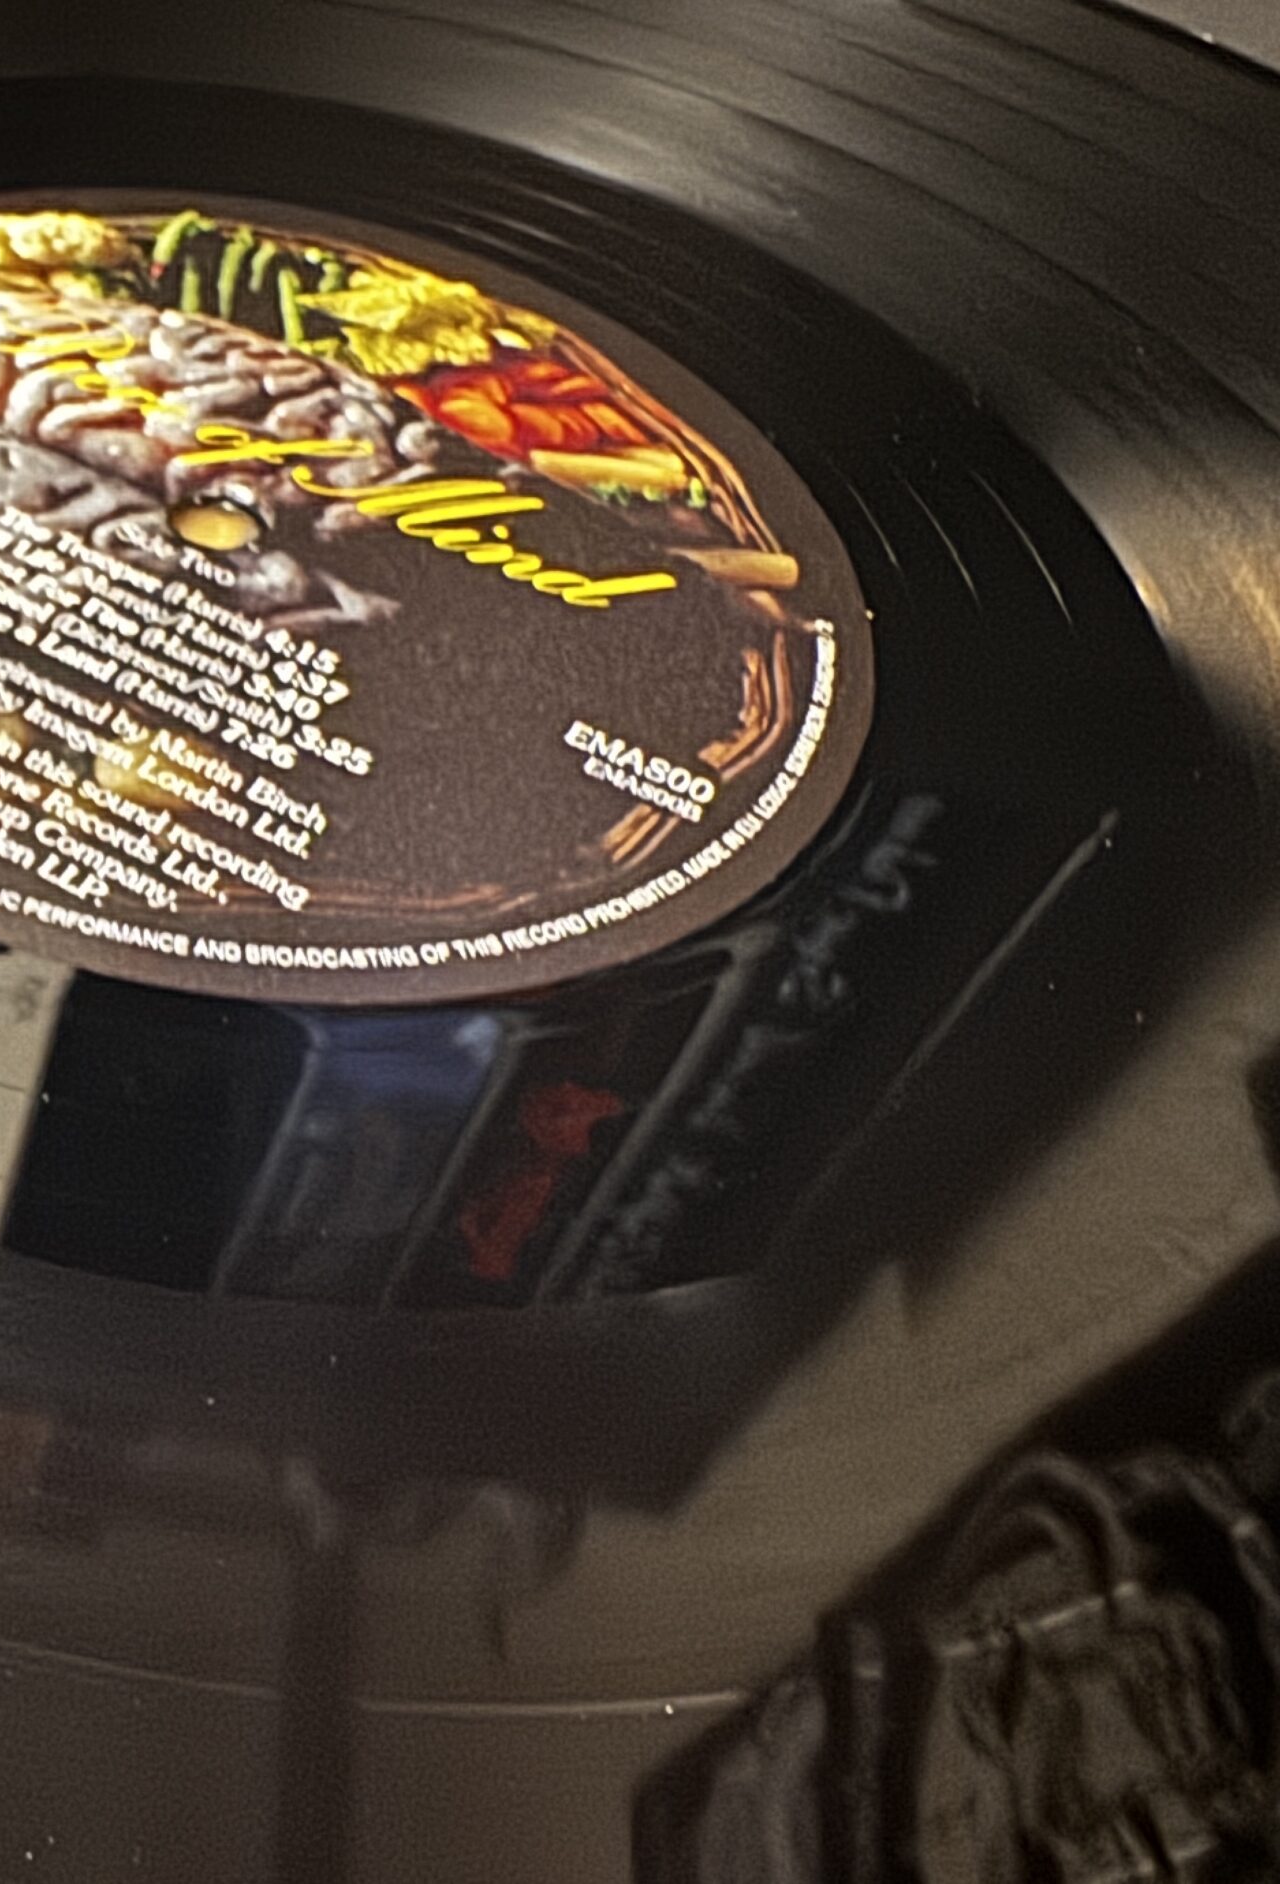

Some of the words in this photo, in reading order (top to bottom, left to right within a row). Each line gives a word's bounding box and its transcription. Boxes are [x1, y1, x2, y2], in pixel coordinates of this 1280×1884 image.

[175, 424, 375, 467] of
[290, 464, 678, 609] Mind
[179, 546, 245, 587] Two
[81, 596, 140, 637] Fire
[140, 627, 243, 686] (Harris)
[243, 672, 321, 721] 3:40
[162, 581, 265, 642] (Harris)
[264, 627, 340, 675] 4:15
[13, 621, 38, 646] a
[38, 630, 119, 683] Land
[114, 670, 219, 733] (Harris)
[220, 717, 298, 770] 7:26
[272, 660, 350, 705] 4:37
[23, 702, 136, 771] Imagem
[137, 754, 250, 829] London
[251, 811, 311, 860] Ltd.
[110, 708, 150, 747] by
[147, 728, 244, 793] Martin
[245, 776, 327, 835] Birch
[292, 724, 373, 775] 3:25
[23, 748, 77, 789] this
[77, 775, 171, 836] sound
[166, 823, 311, 912] recording
[41, 787, 159, 865] Records
[36, 852, 110, 908] LLP.
[22, 896, 190, 957] PERFORMANCE
[192, 937, 242, 963] AND
[244, 943, 420, 970] BROADCASTING
[419, 941, 451, 965] OF
[450, 933, 504, 960] THIS
[501, 913, 589, 952] RECORD
